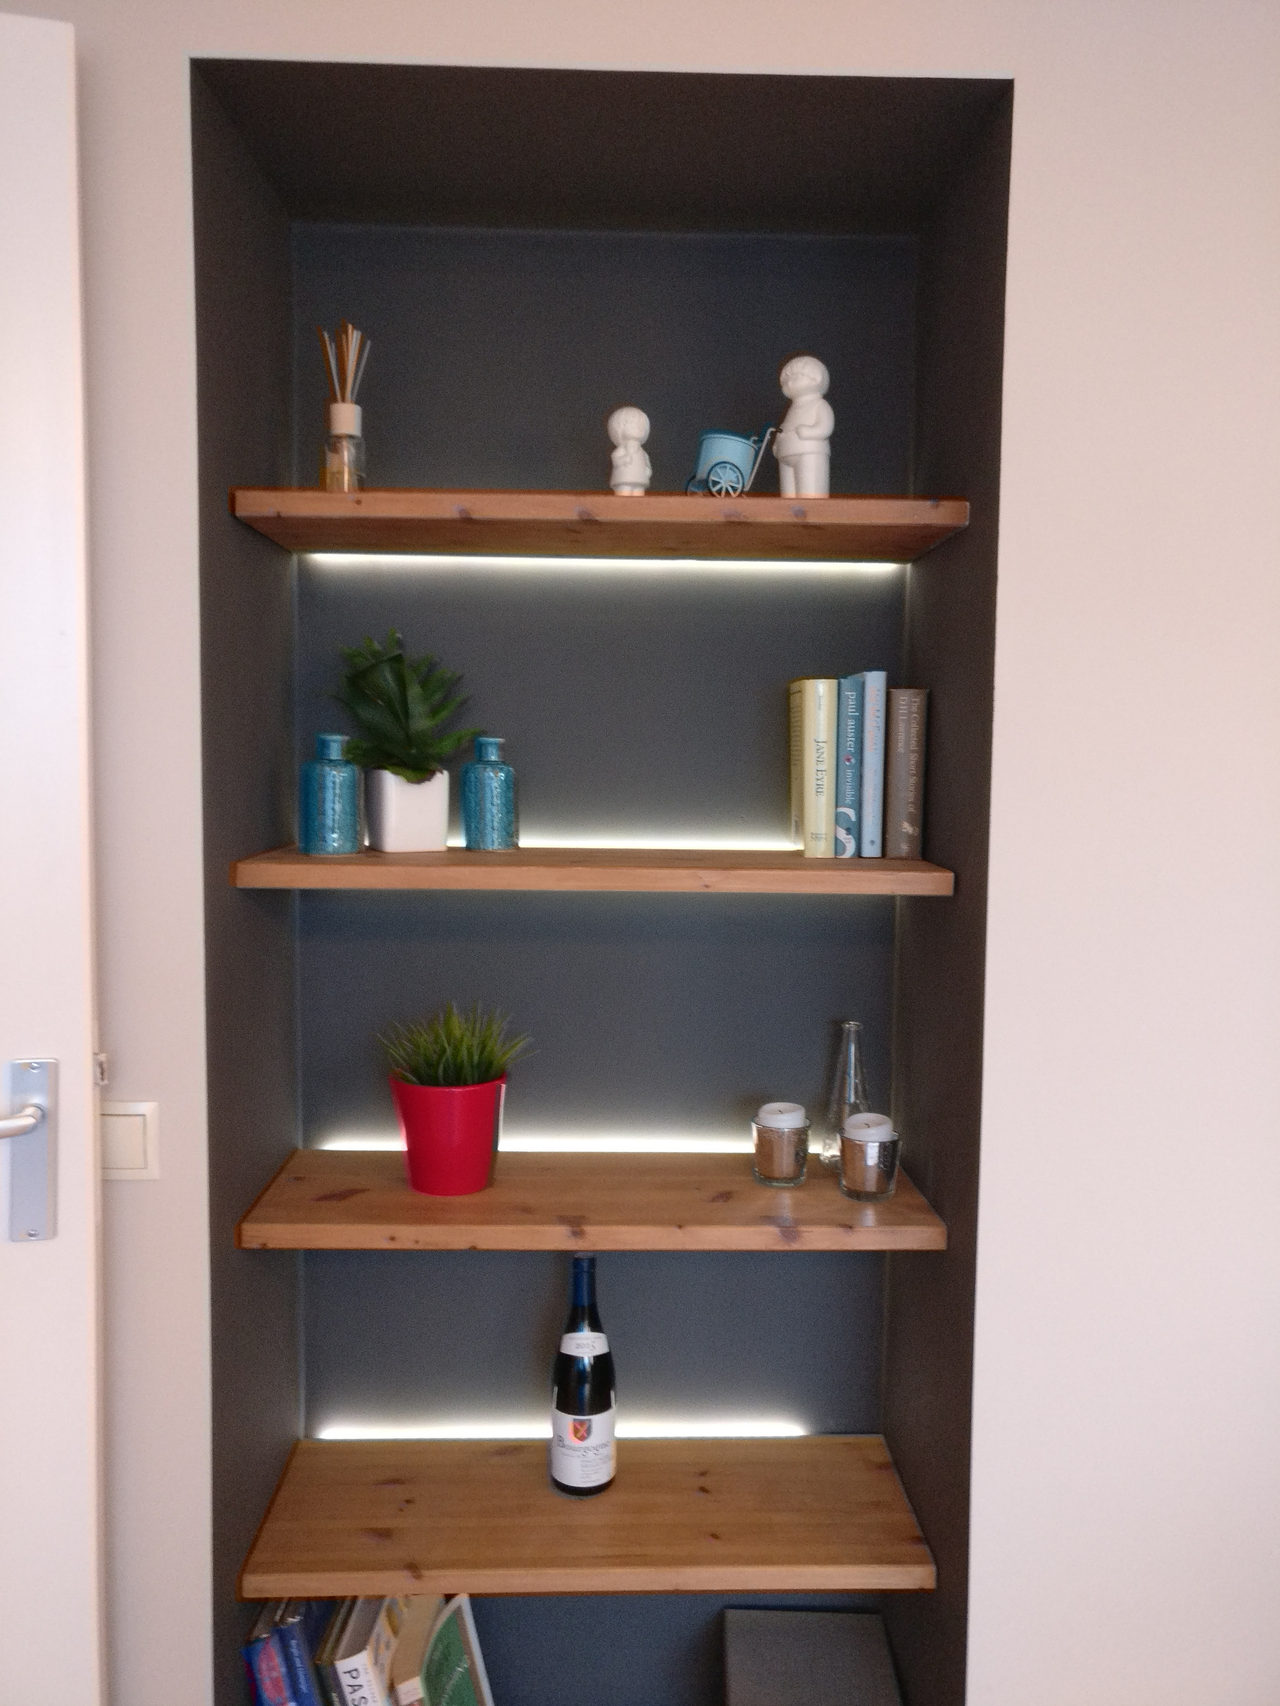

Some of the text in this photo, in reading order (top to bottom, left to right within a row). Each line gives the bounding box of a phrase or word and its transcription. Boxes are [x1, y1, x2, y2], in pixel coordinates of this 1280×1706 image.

[845, 691, 859, 752] paul auster
[909, 713, 920, 750] Collected
[814, 739, 828, 797] JANE EYRE
